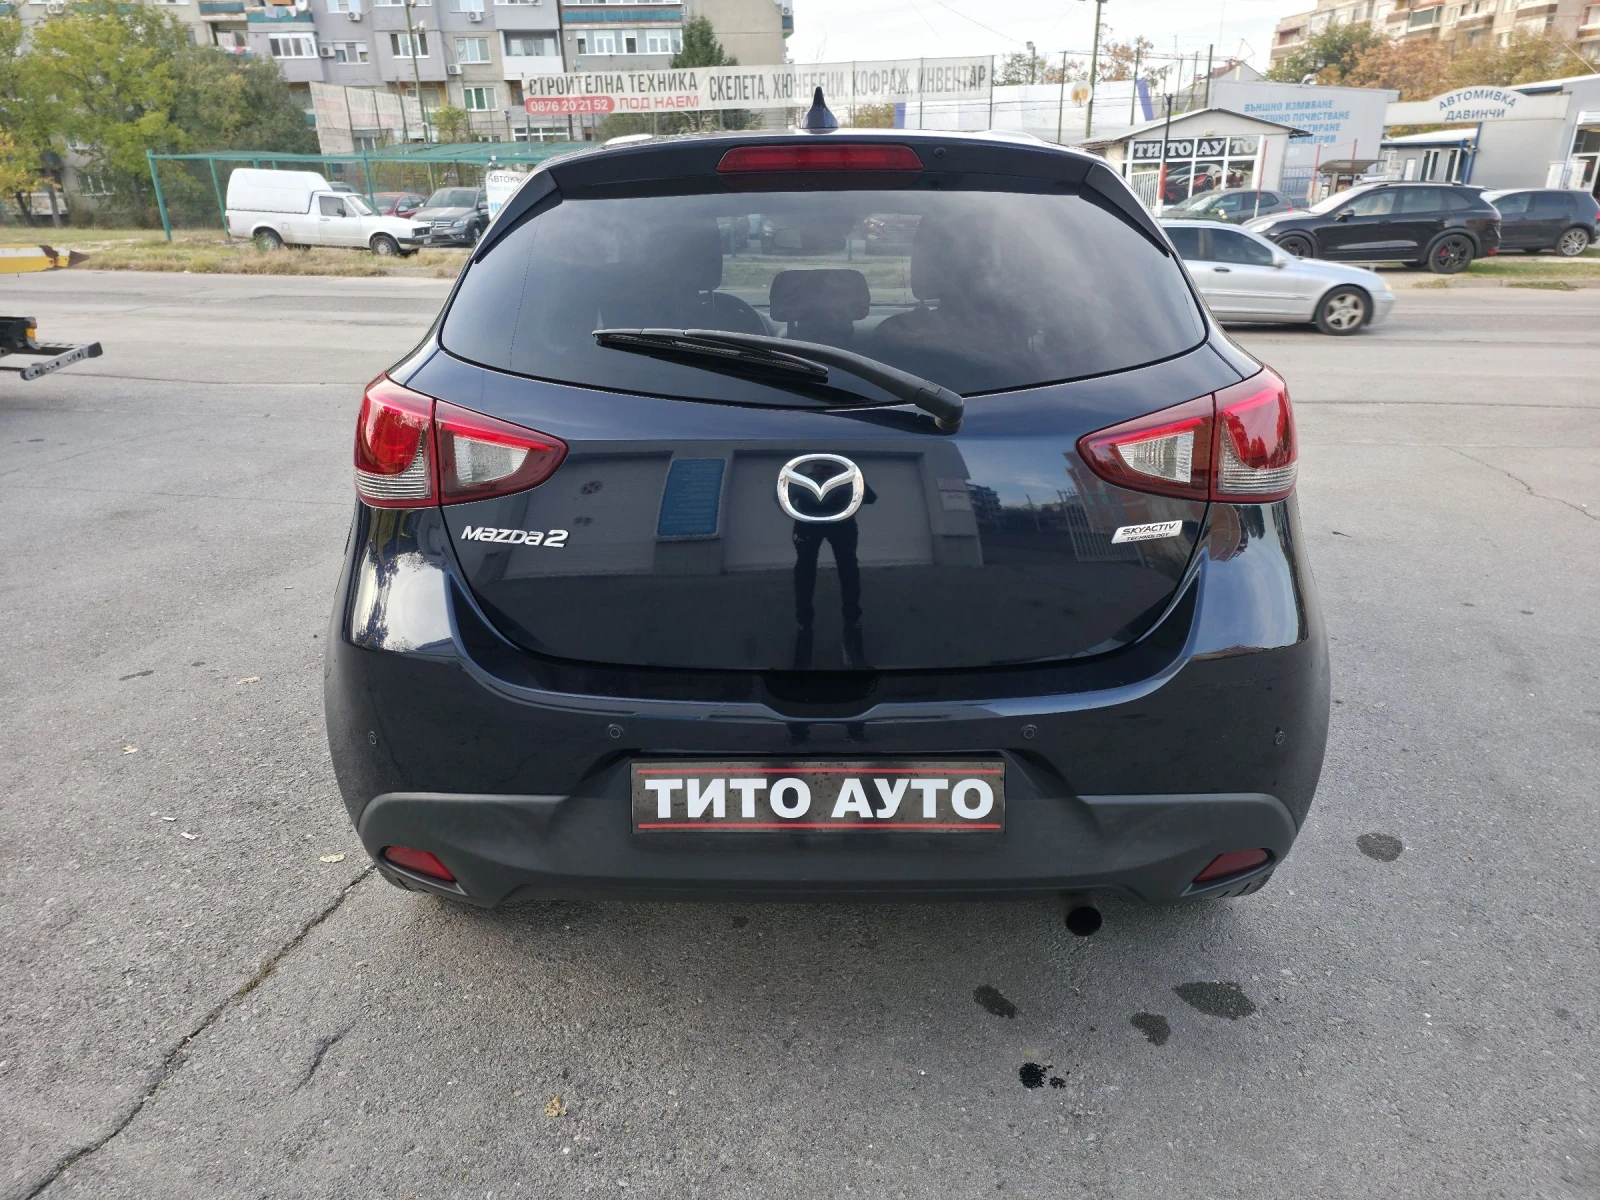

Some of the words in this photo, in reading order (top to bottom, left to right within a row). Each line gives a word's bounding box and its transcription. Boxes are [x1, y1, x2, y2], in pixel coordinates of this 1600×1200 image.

[529, 74, 624, 95] СТРОИТЕЛНА
[628, 72, 698, 93] ТЕХНИКА
[709, 74, 769, 103] СКЕЛЕТА,
[917, 64, 986, 94] ИНВЕНТАР
[530, 101, 559, 112] 0876
[562, 101, 577, 111] 20
[579, 100, 591, 111] 21
[594, 99, 608, 111] 52
[620, 97, 650, 111] ПОД
[655, 95, 699, 109] НАЕМ
[1244, 103, 1282, 113] ВЪНШНО
[1285, 100, 1333, 111] ИЗМИВАНЕ
[1439, 89, 1516, 111] АВТОМИВКА
[1292, 111, 1350, 121] ПОЧИСТВАНЕ
[1445, 108, 1505, 122] ДАВИНЧИ
[1134, 142, 1192, 157] ТИТО
[1197, 140, 1257, 155] АУТО
[1121, 522, 1176, 535] SKYACTIV
[1126, 532, 1169, 541] TECHNOLOGY
[645, 777, 811, 819] ТИТО
[831, 778, 994, 819] АУТО
